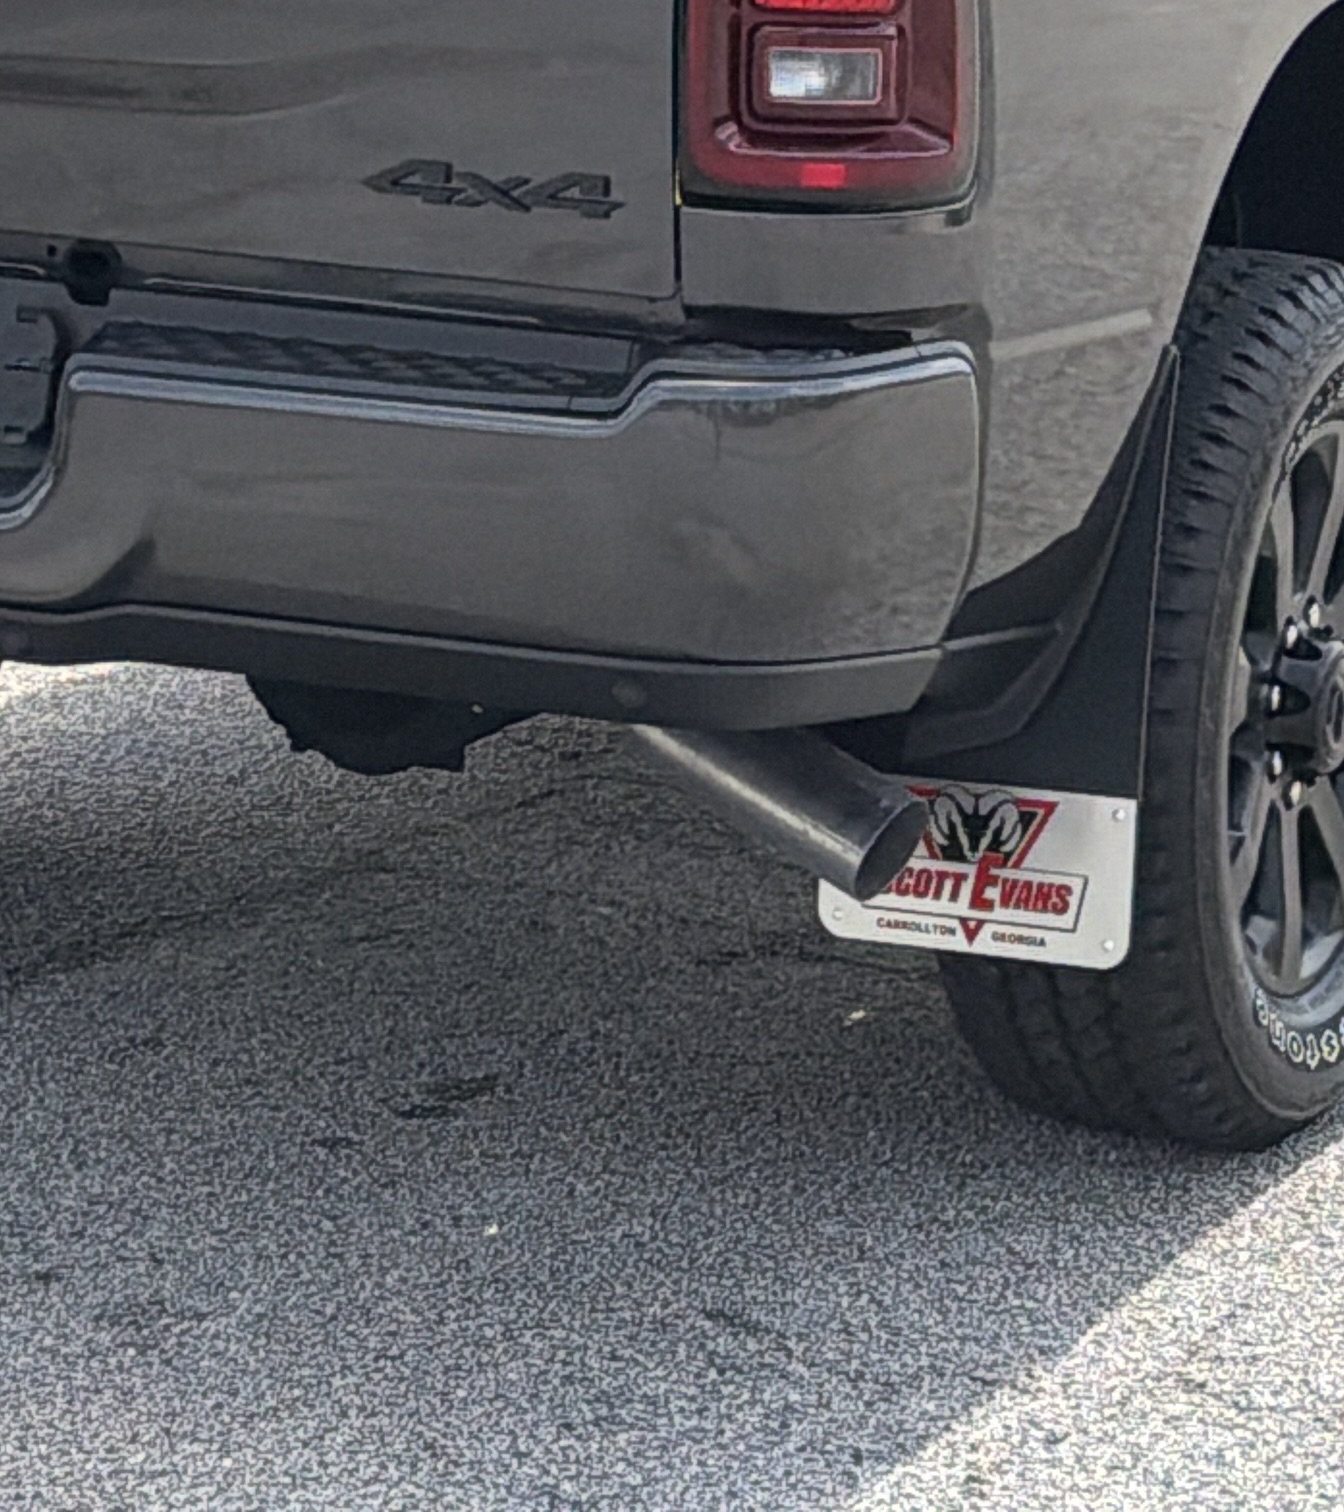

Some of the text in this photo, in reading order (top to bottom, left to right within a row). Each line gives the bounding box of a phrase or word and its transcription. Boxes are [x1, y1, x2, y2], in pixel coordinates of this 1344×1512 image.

[968, 851, 1075, 917] EVANS
[875, 916, 1048, 948] CARROLLTON GEORGIA
